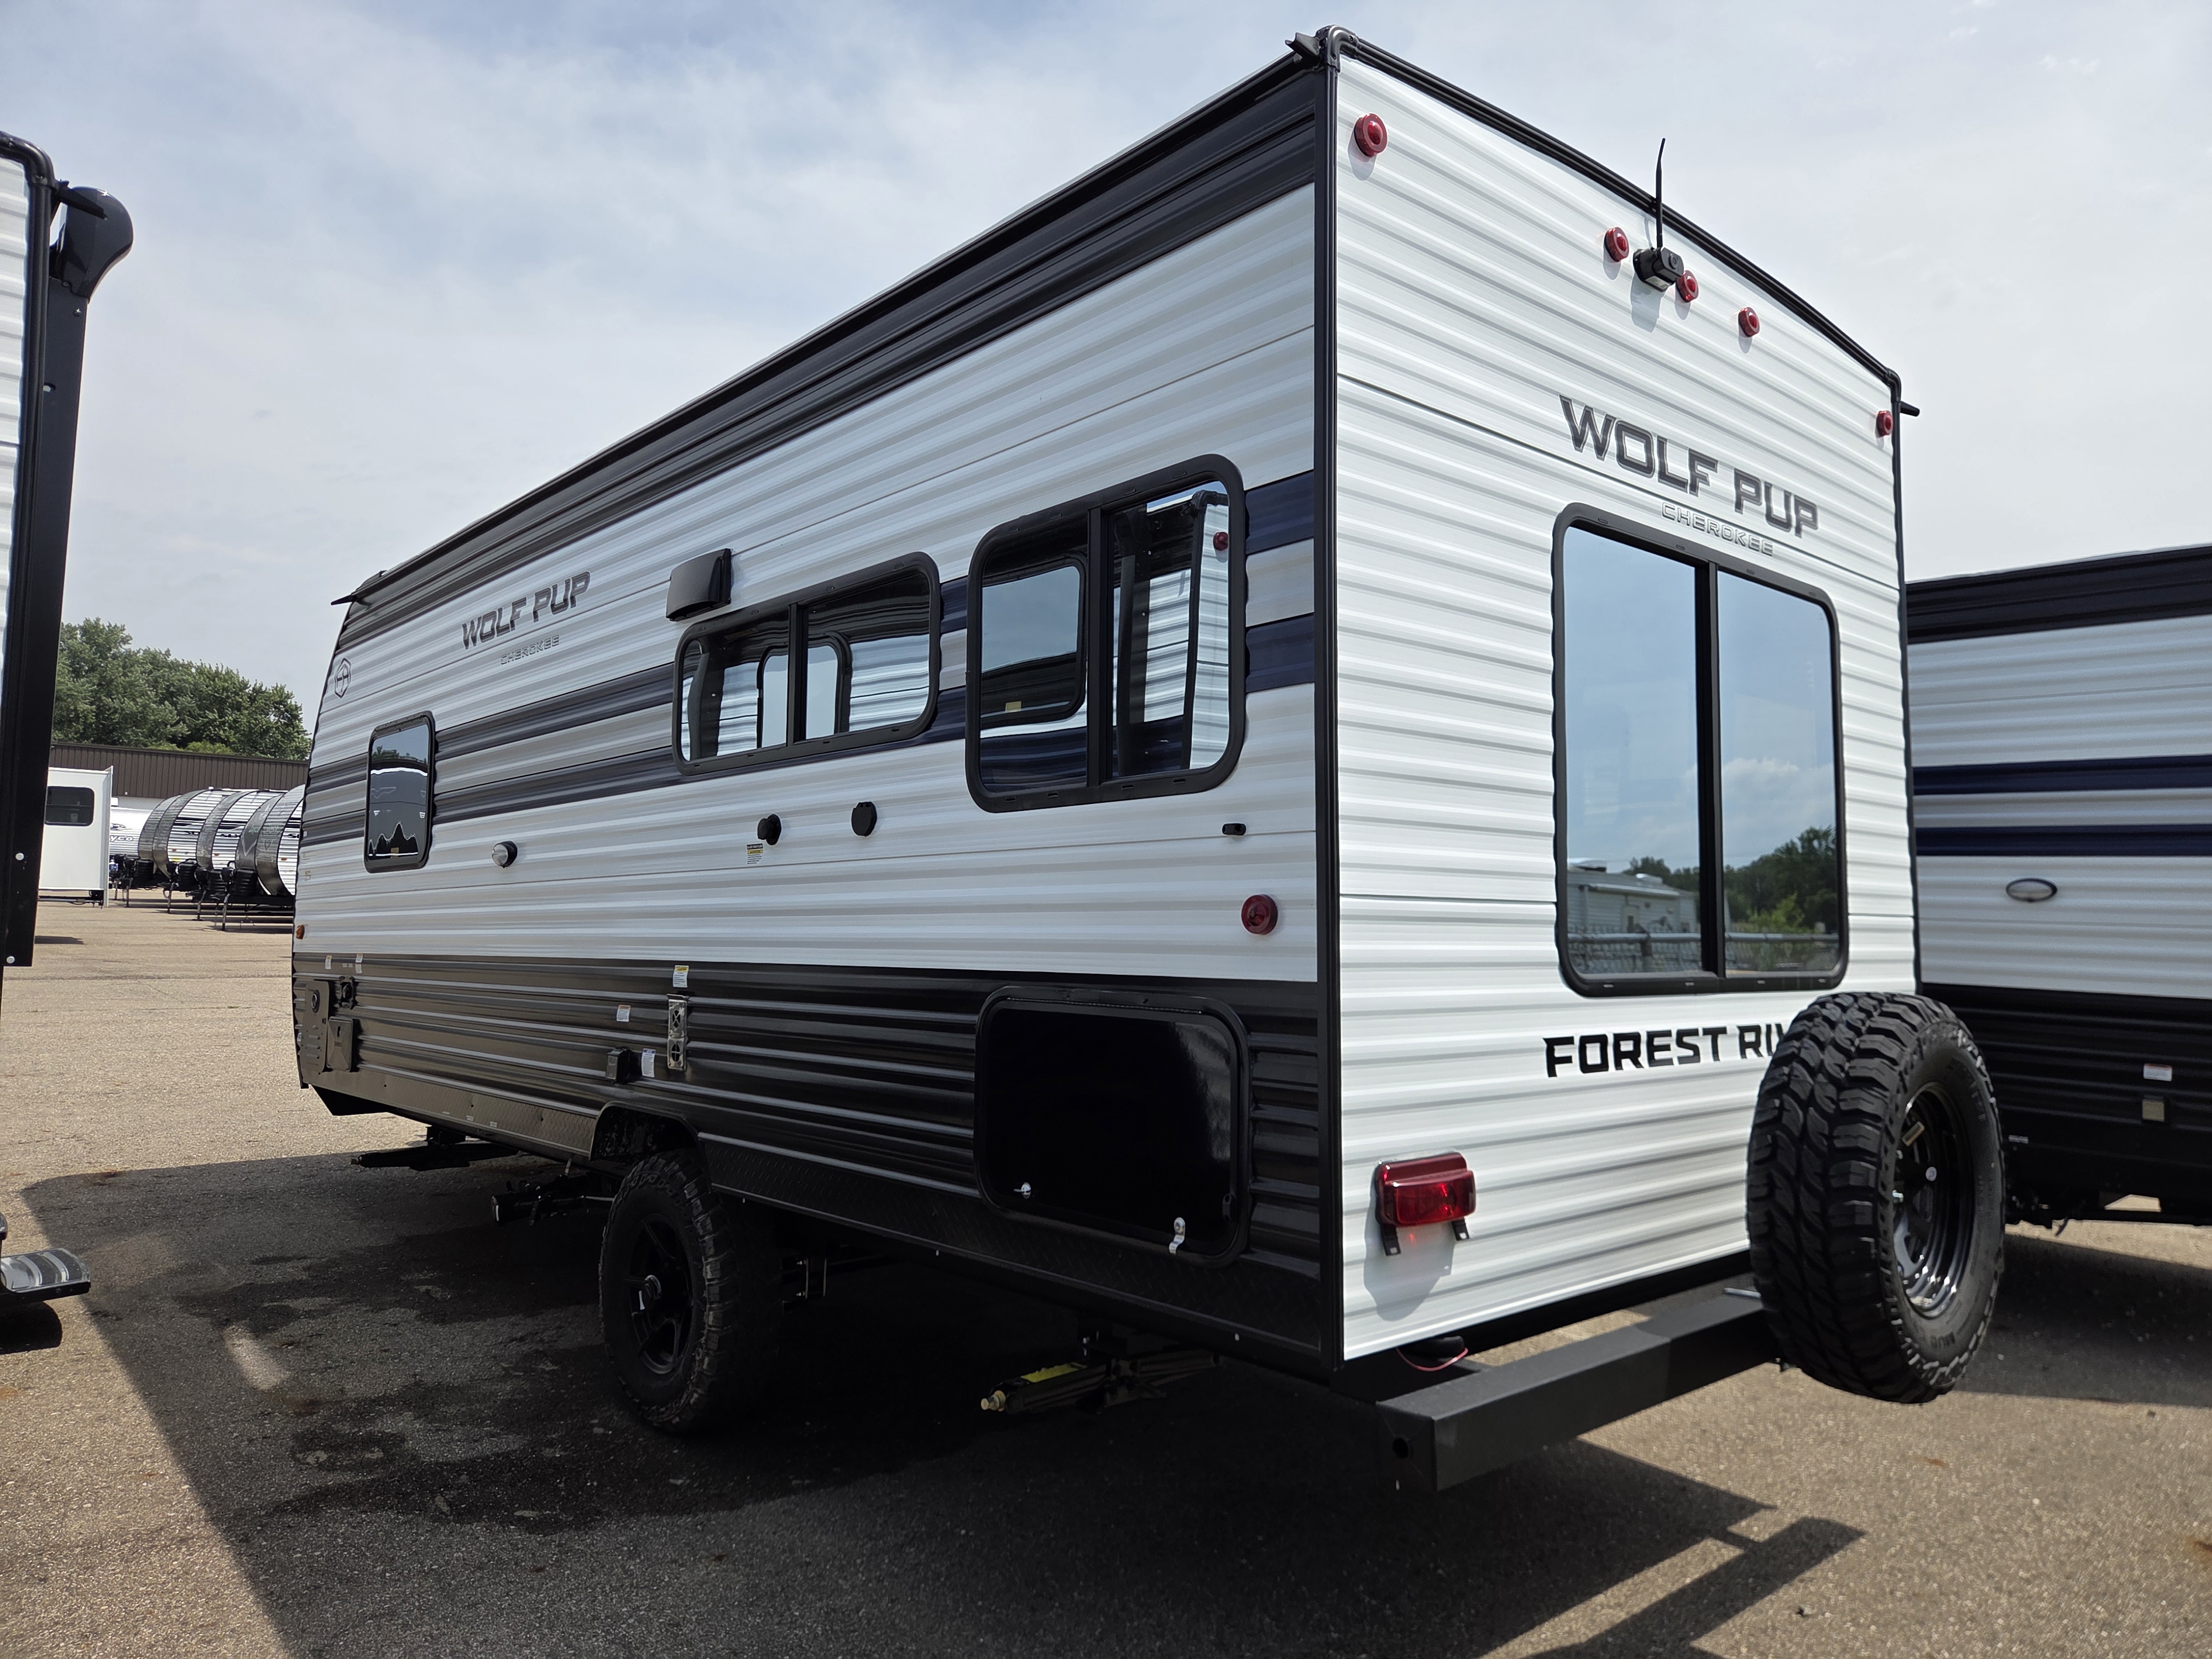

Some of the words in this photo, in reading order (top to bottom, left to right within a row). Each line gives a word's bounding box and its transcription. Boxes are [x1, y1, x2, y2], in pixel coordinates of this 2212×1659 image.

[1559, 394, 1718, 497] WOLF
[1733, 467, 1819, 539] PUP
[1662, 502, 1773, 556] CHEROKEE
[462, 597, 526, 650] WOLF
[533, 571, 591, 623] PUP
[500, 634, 560, 665] CHEROKEE
[1542, 1026, 1728, 1078] FOREST
